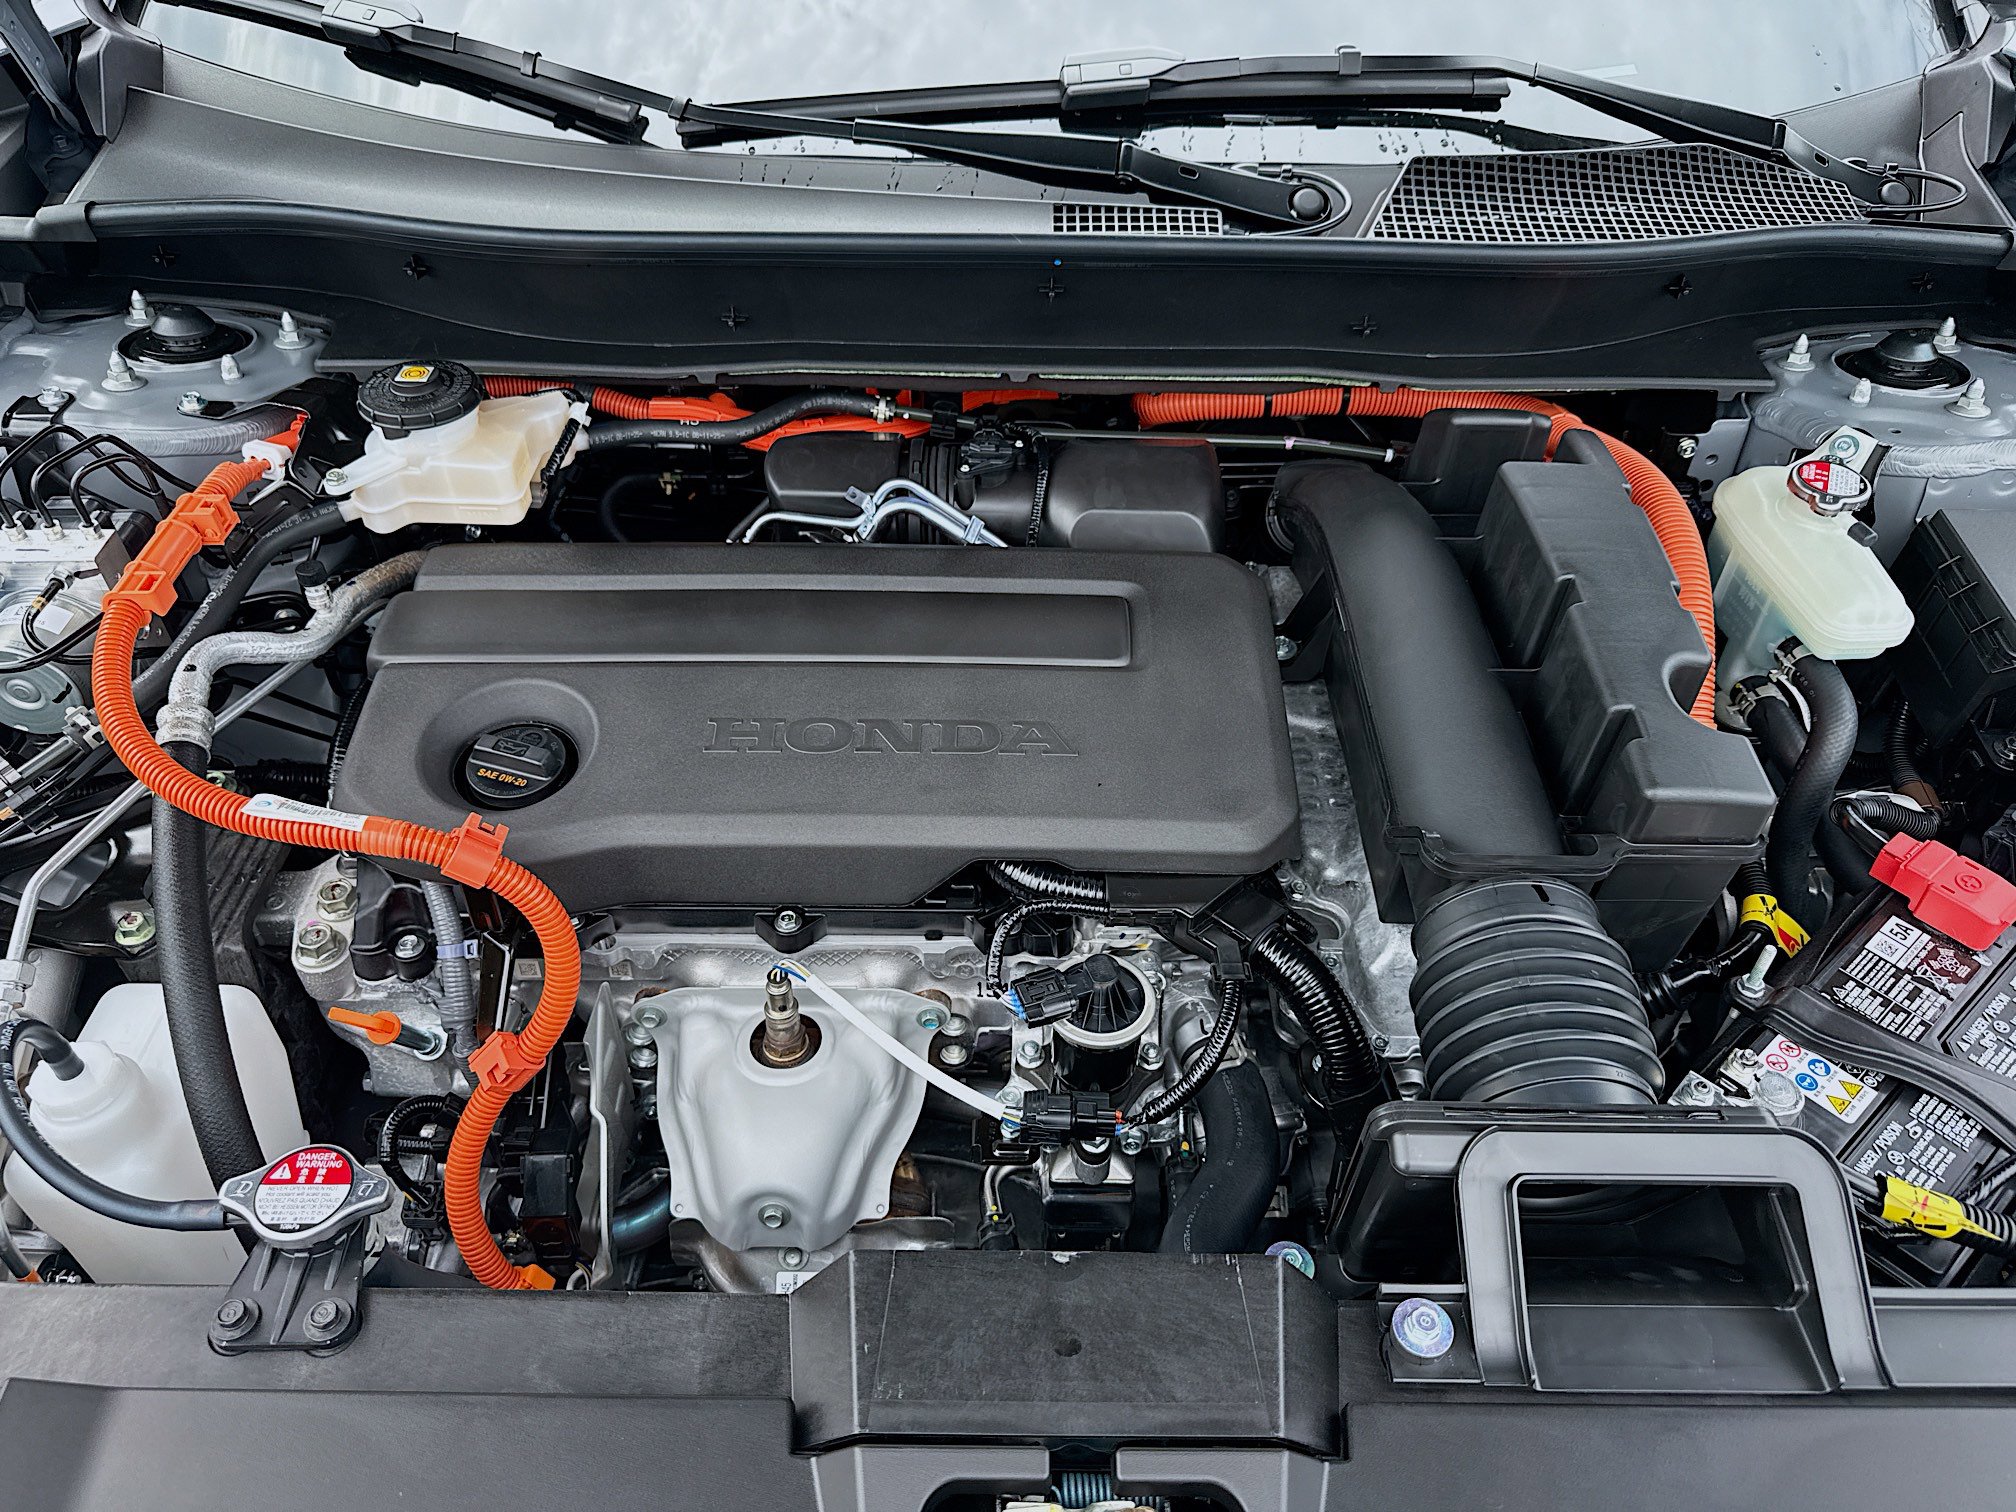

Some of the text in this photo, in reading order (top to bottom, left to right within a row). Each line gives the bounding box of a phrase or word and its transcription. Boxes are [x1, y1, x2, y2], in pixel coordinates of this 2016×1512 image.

[702, 717, 1080, 757] HONDA
[477, 768, 528, 787] SAE 0W-20
[1889, 923, 1914, 940] 5A
[298, 1152, 338, 1161] DANGER
[1854, 1120, 1904, 1176] ANGER/POISON
[295, 1160, 344, 1169] WARNUNG
